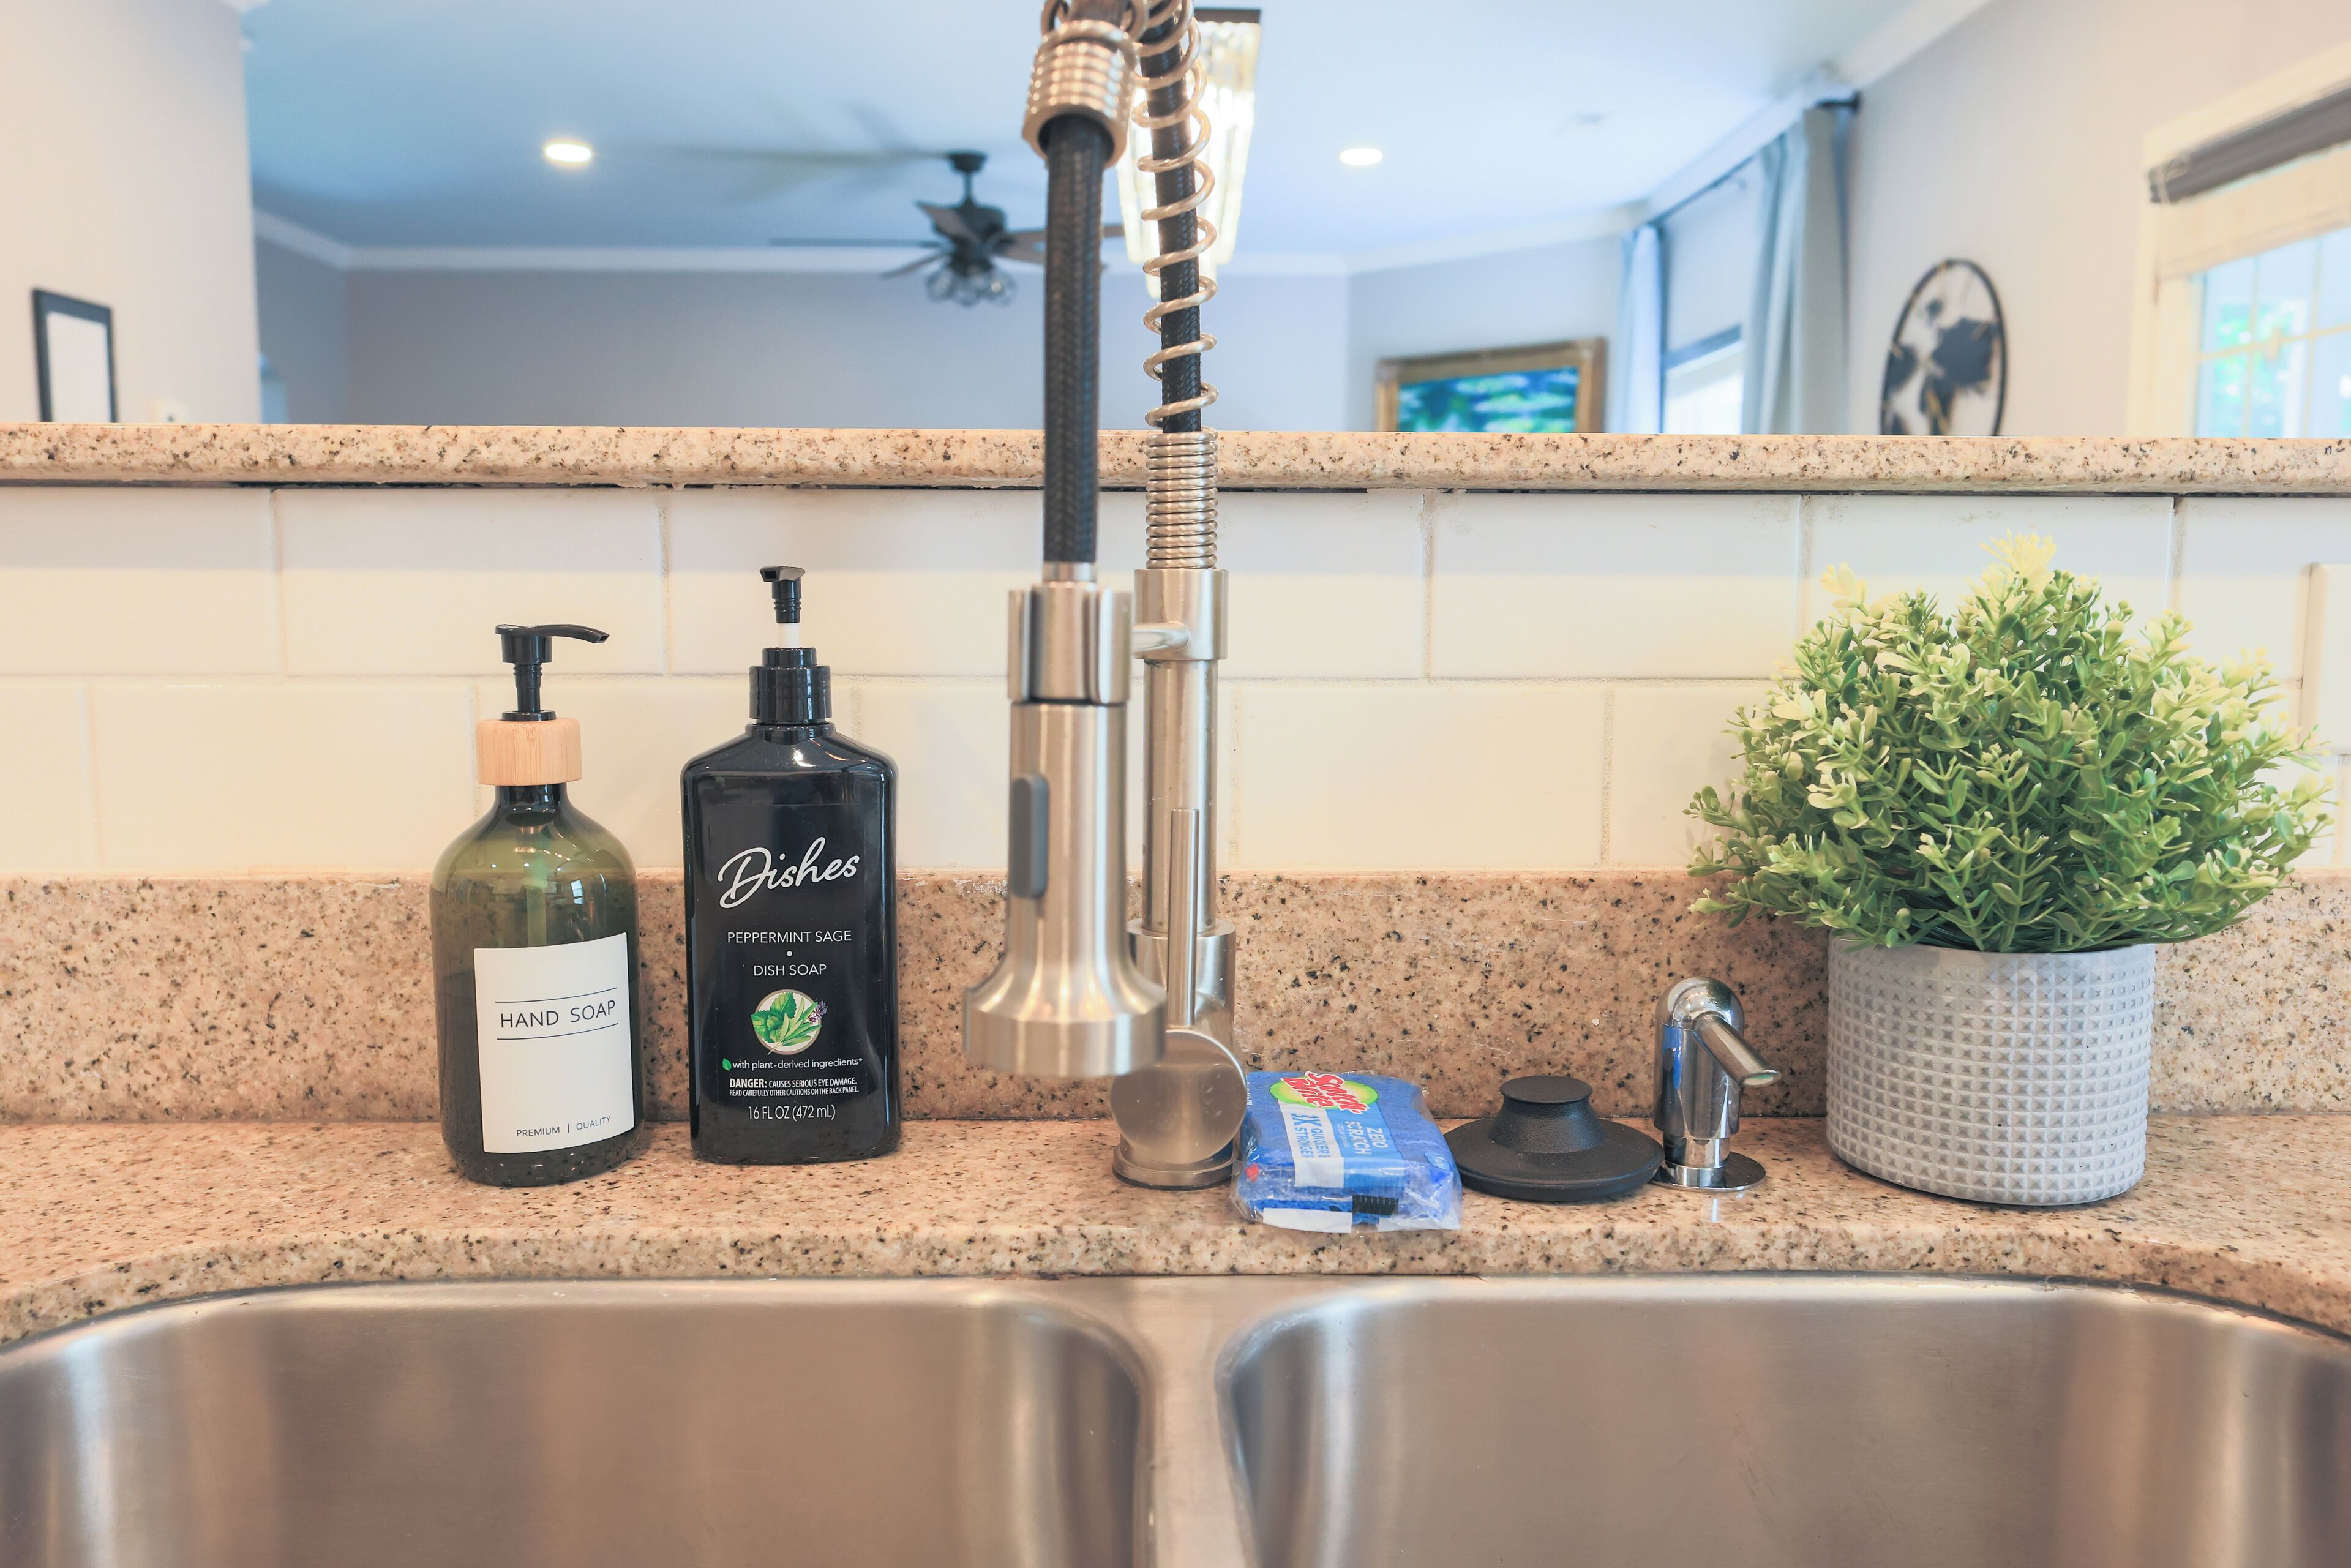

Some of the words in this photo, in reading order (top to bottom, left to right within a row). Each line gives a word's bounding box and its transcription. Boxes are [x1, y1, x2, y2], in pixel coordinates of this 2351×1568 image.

[718, 836, 860, 909] Dishes
[727, 931, 812, 943] PEPPERMINT
[815, 930, 852, 943] SAGE
[753, 964, 785, 976] DISH
[789, 964, 827, 976] SOAP
[500, 1010, 560, 1028] HAND
[570, 1000, 616, 1023] SOAP
[732, 1060, 750, 1068] with
[752, 1059, 809, 1071] plant-derived
[729, 1078, 767, 1088] DANGER:
[792, 1079, 817, 1088] SERIOUS
[830, 1077, 857, 1086] DAMAGE.
[1283, 1078, 1335, 1107] Brite
[748, 1106, 760, 1120] 16
[762, 1106, 773, 1119] FL
[774, 1106, 790, 1119] OZ
[792, 1105, 814, 1122] (472
[817, 1104, 836, 1120] mL)
[1291, 1113, 1322, 1127] 3X
[516, 1126, 560, 1137] PREMIUM
[576, 1115, 611, 1131] QUALITY
[1344, 1120, 1372, 1155] SCRATCH
[1367, 1127, 1389, 1149] ZERO
